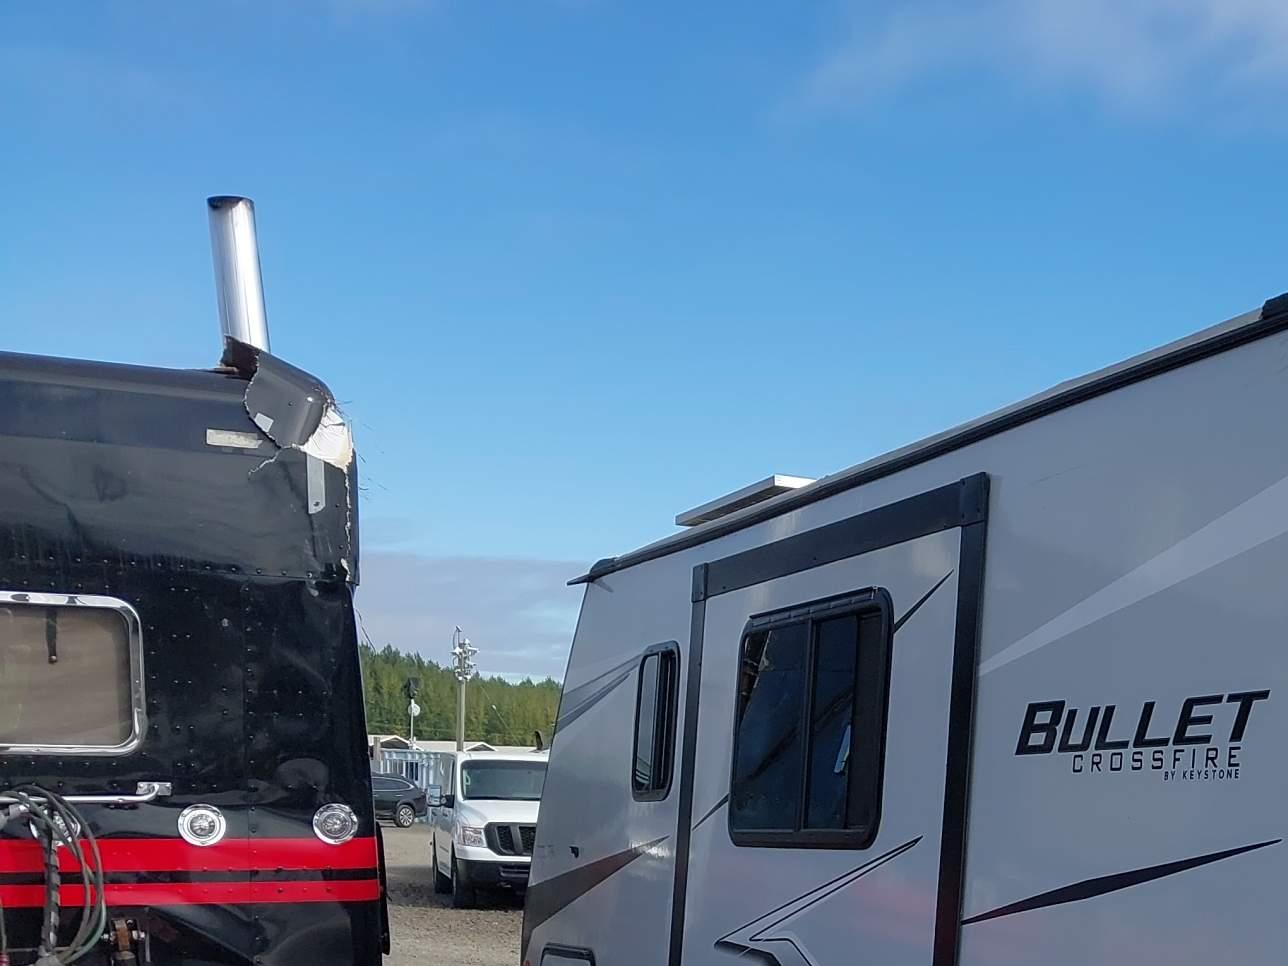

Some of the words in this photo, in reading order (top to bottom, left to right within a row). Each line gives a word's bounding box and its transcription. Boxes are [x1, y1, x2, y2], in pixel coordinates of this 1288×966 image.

[1015, 690, 1271, 756] BULLET
[1072, 746, 1241, 773] CROSSFIRE
[1164, 771, 1176, 780] BY
[1182, 768, 1240, 780] KEYSTONE
